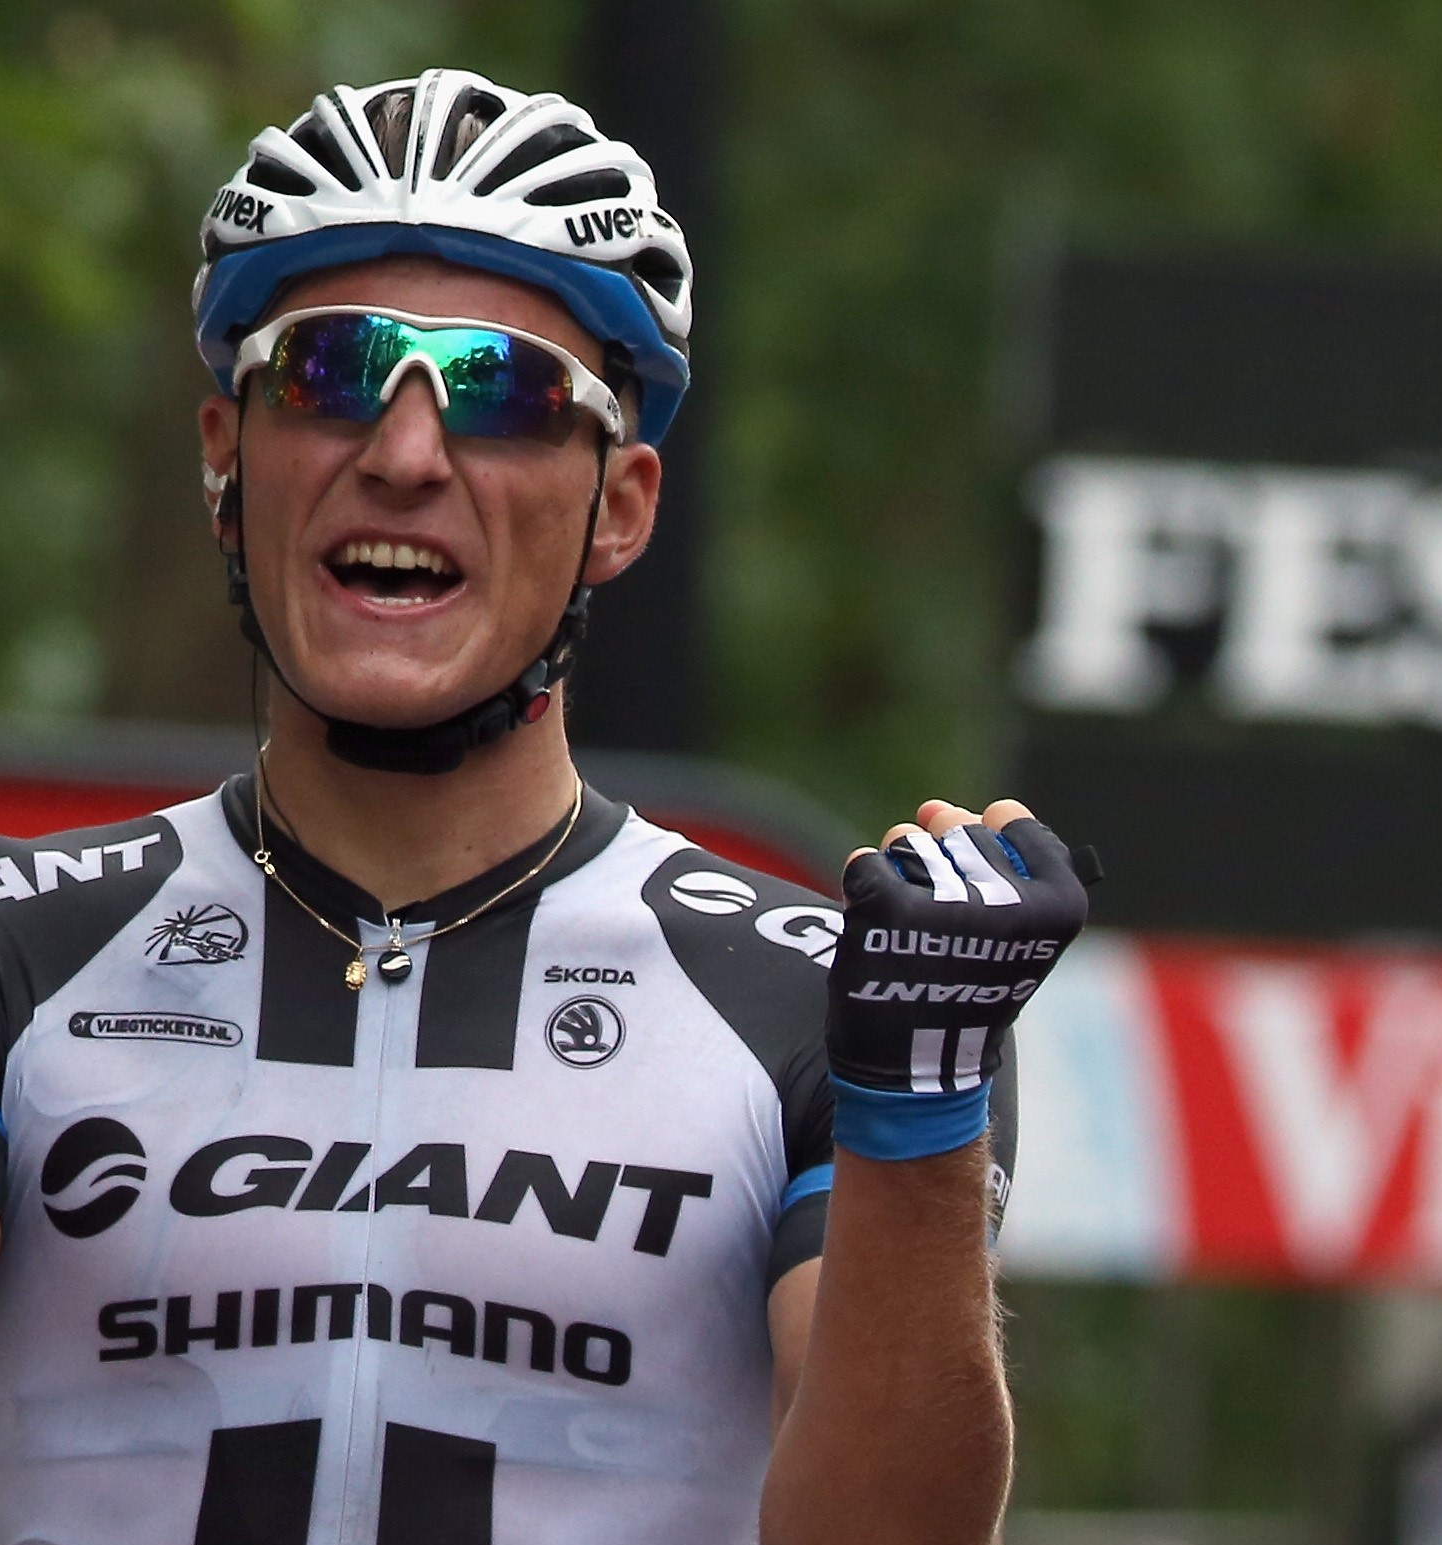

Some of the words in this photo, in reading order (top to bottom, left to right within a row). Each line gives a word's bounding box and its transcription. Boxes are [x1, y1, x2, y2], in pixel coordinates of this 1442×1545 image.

[211, 190, 274, 234] uvex
[863, 928, 1058, 962] SHIMANO
[847, 980, 1010, 1004] GIANT
[96, 1018, 232, 1041] VLIEGTICKETS.NL
[170, 1135, 713, 1257] GIANT
[99, 1283, 632, 1387] SHIMANO
